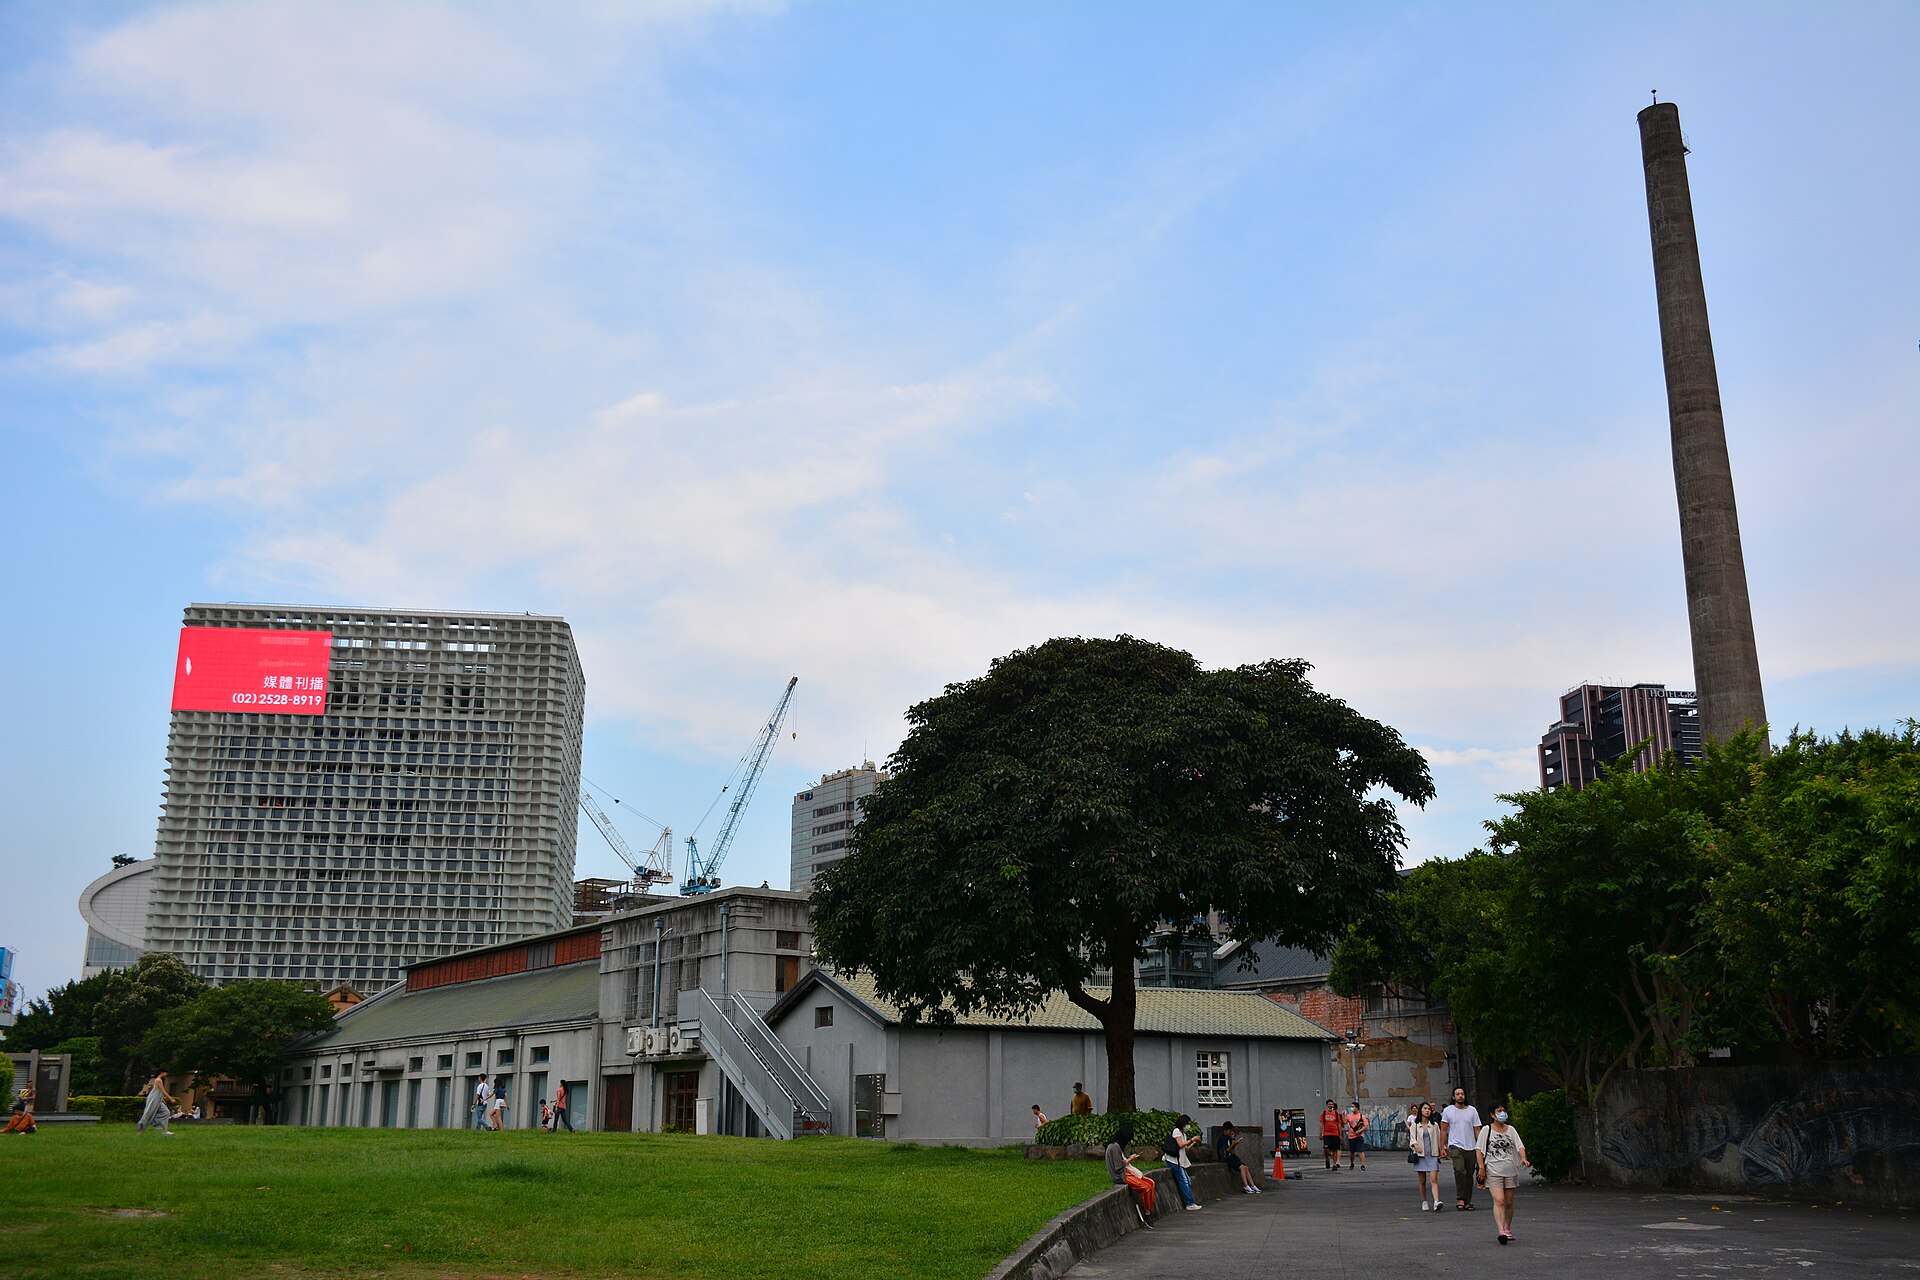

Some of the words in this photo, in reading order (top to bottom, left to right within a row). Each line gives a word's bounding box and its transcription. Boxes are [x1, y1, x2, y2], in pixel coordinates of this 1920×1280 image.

[263, 675, 324, 691] 媒體刊播
[1650, 689, 1679, 698] HOTEL
